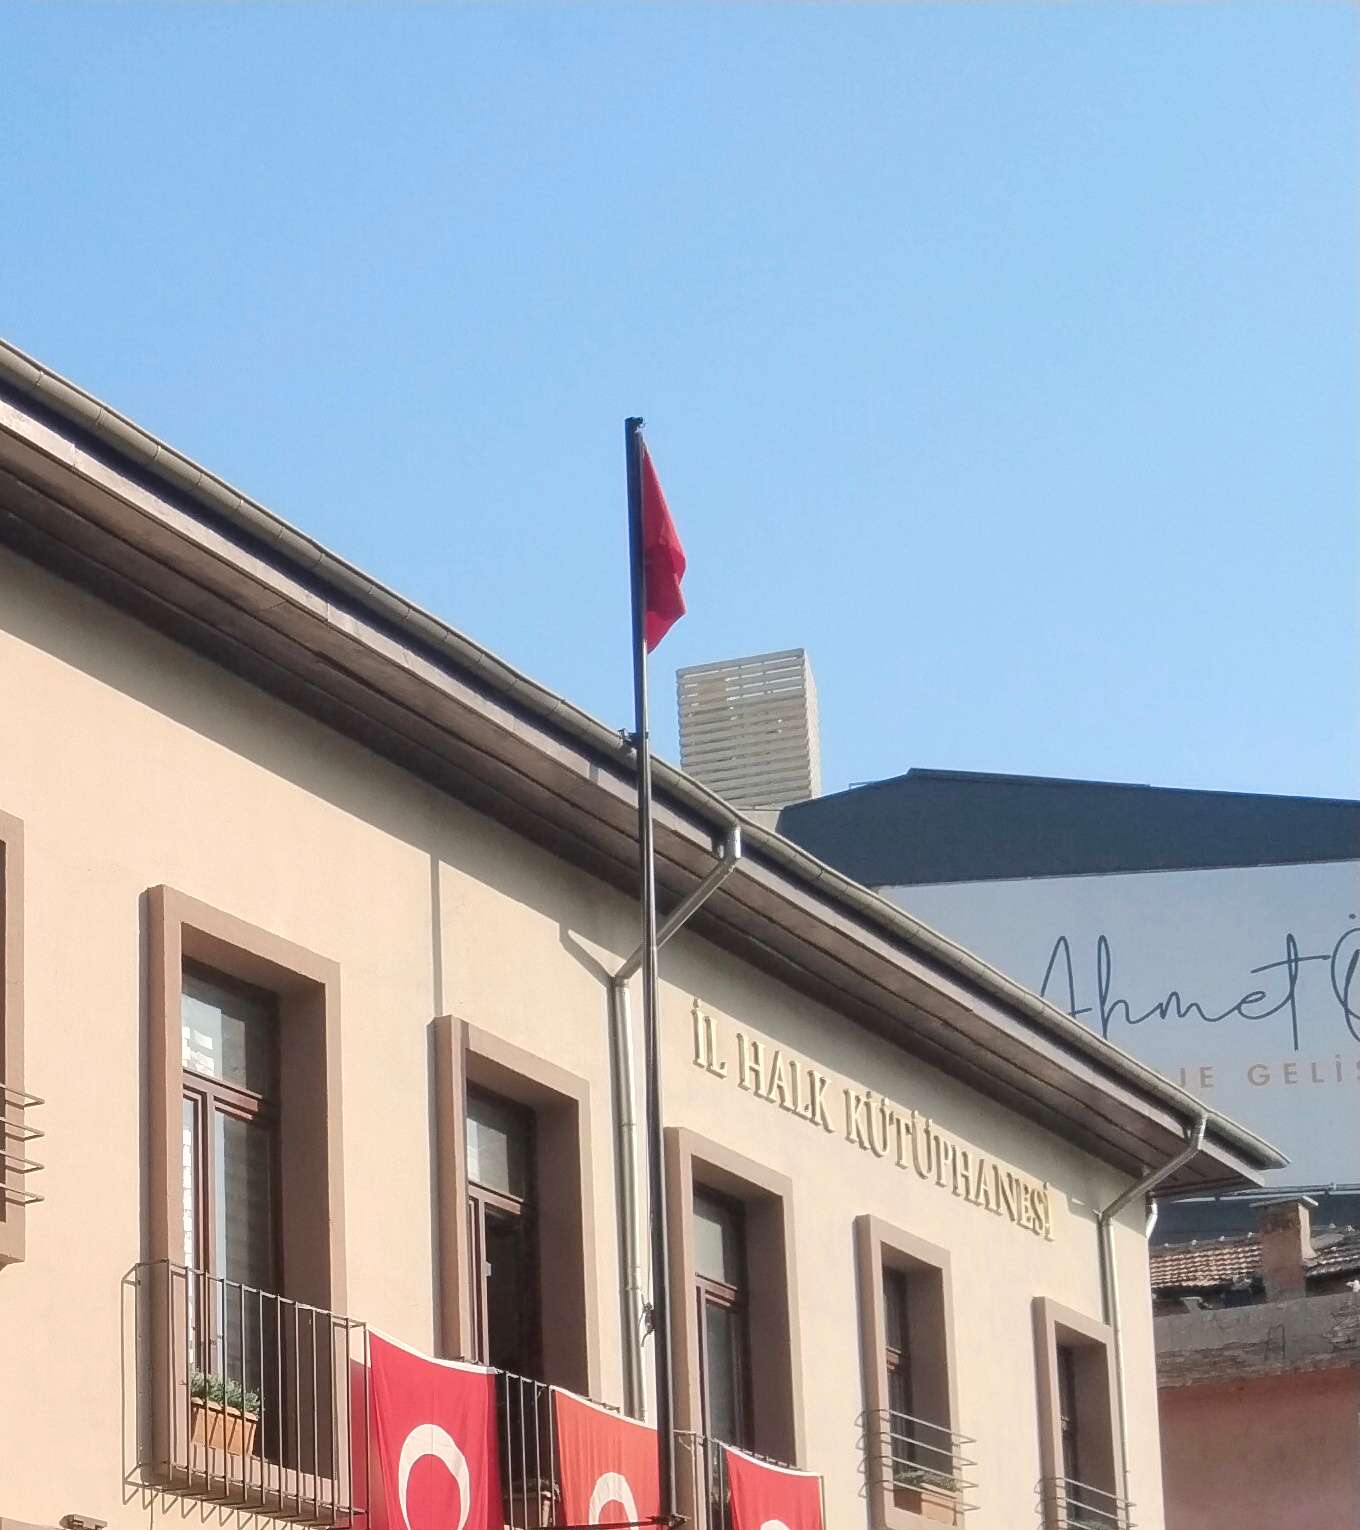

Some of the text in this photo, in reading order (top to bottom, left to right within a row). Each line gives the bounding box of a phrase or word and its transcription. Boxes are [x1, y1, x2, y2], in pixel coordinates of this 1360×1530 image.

[1041, 933, 1331, 1051] Ahmet
[691, 998, 1055, 1242] İL HALK KÜTÜPHANESİ
[1247, 1054, 1360, 1087] GELİ
